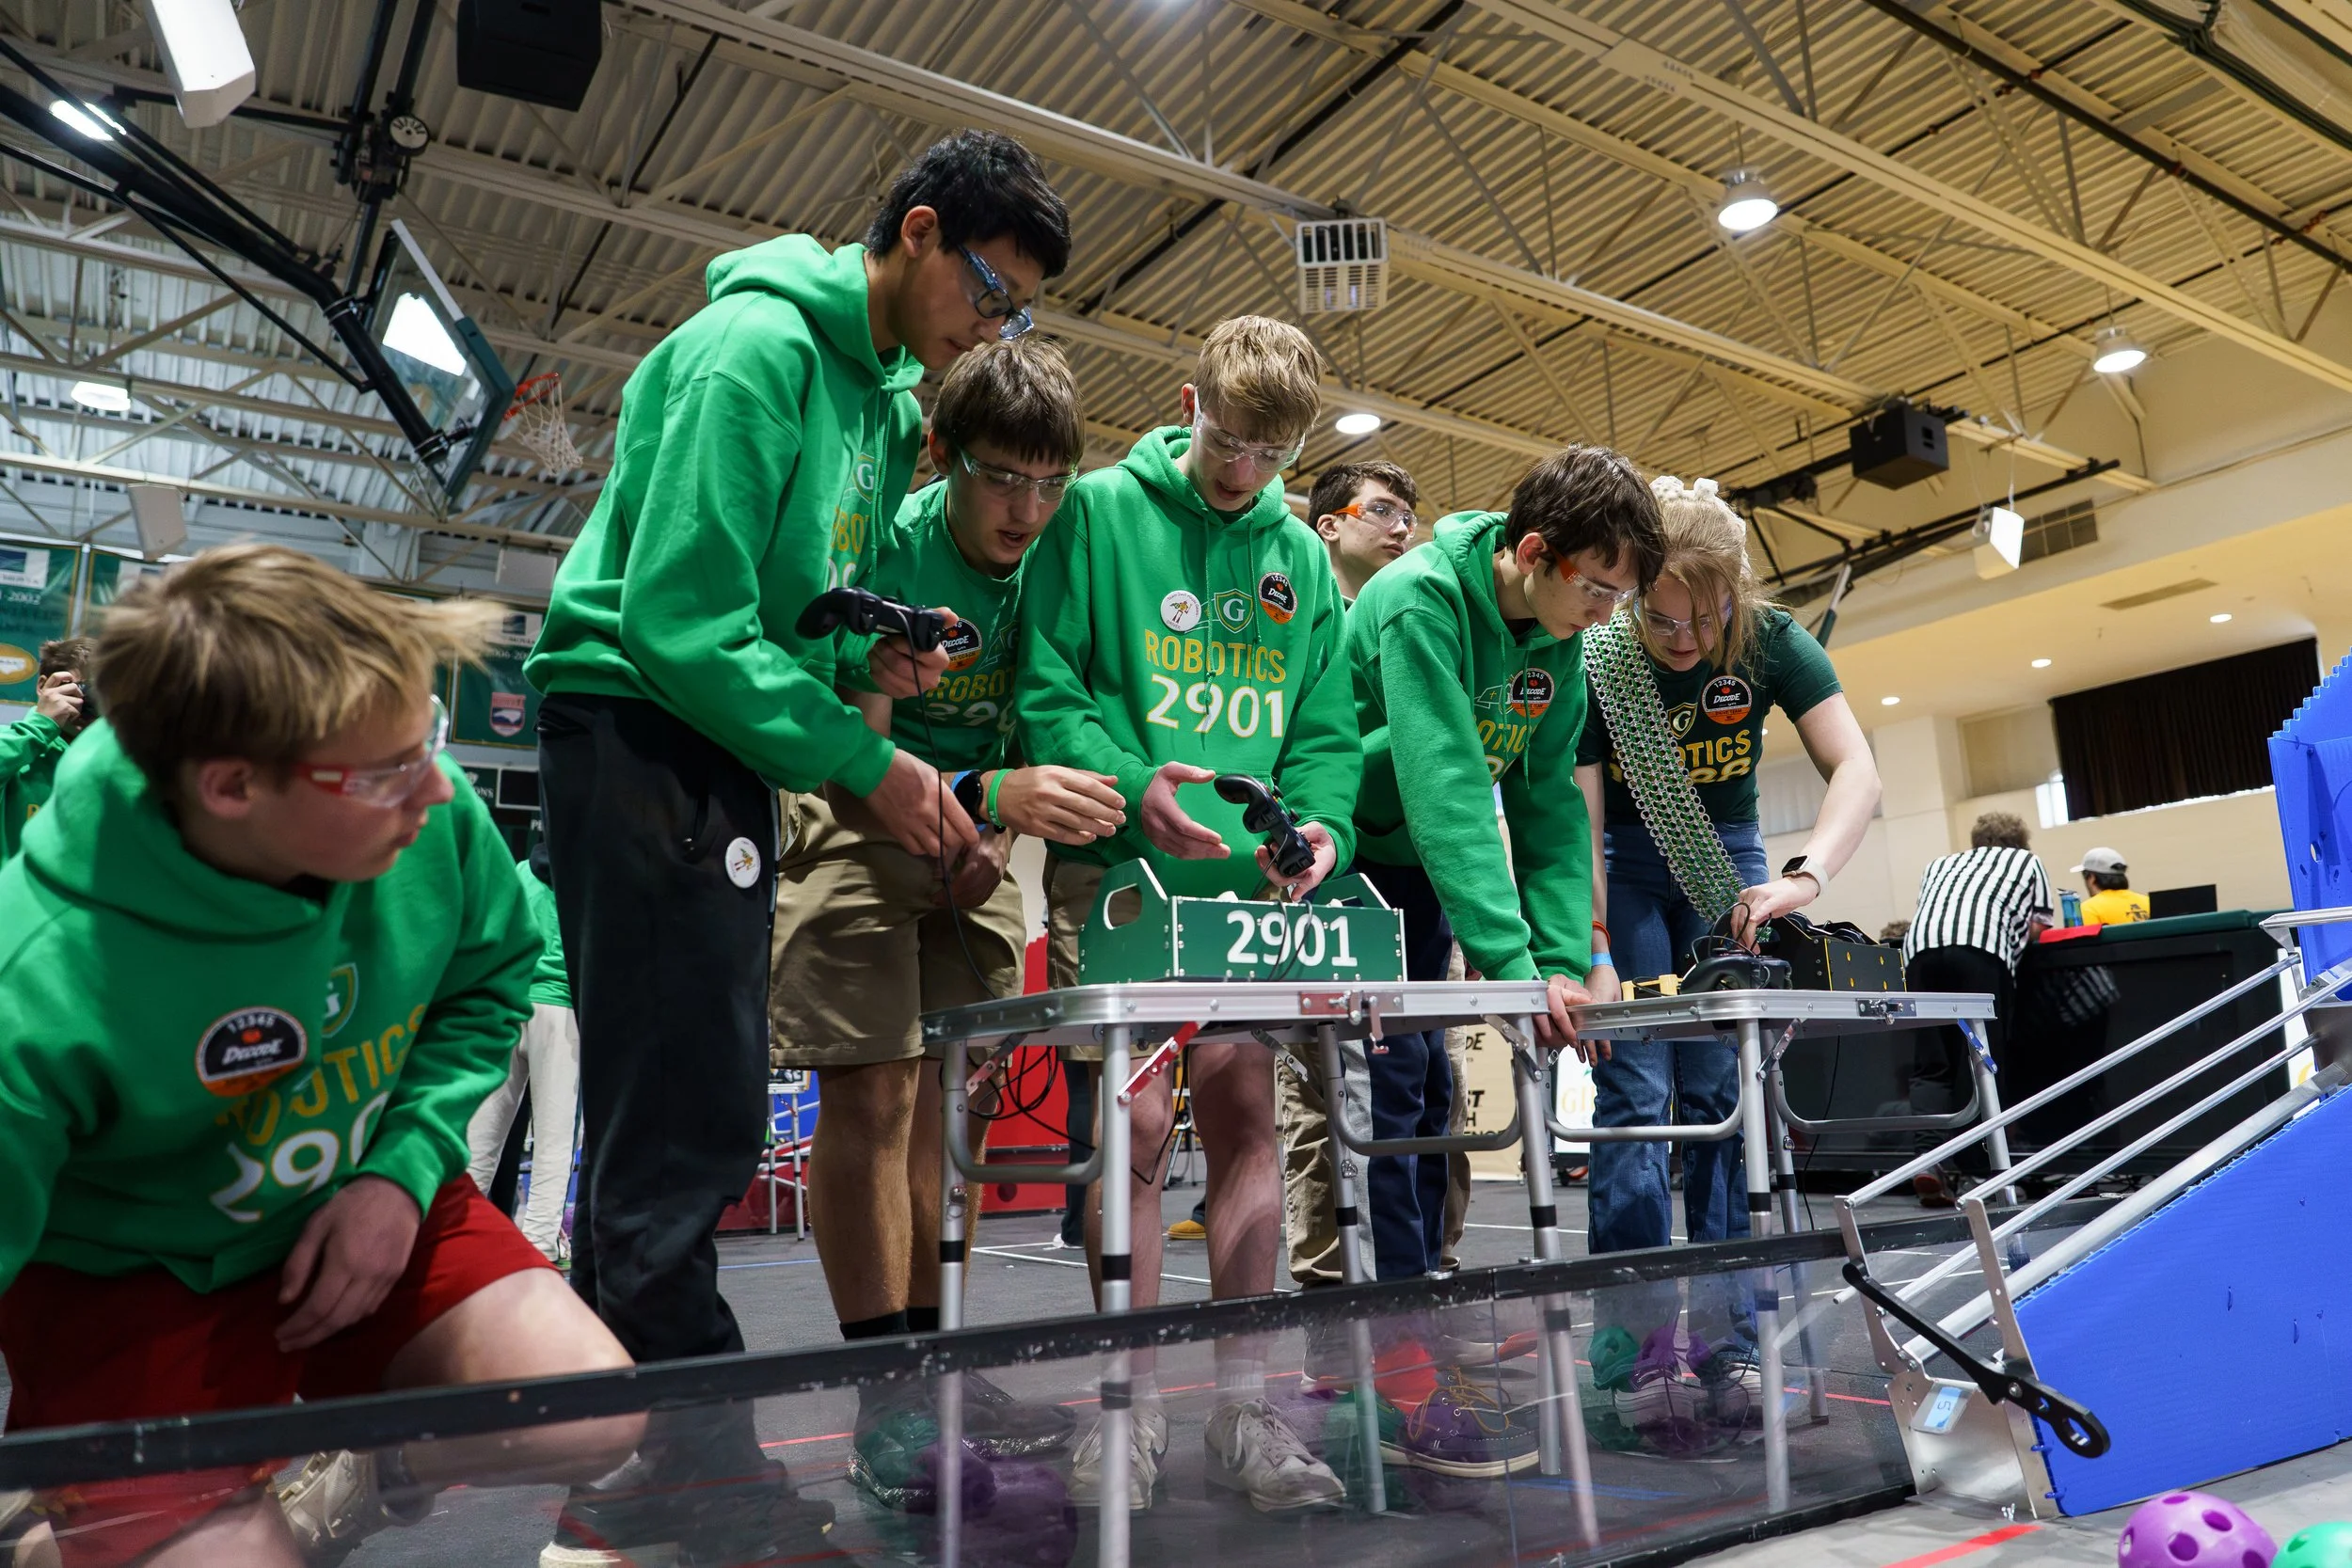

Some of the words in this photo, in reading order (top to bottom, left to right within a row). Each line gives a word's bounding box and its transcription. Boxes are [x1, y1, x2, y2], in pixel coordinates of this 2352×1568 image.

[857, 463, 875, 490] G
[1223, 598, 1246, 622] G
[942, 635, 970, 649] DECODE
[1145, 629, 1287, 684] ROBOTICS
[1527, 671, 1545, 680] 2345
[1714, 679, 1737, 688] 12345
[1146, 673, 1285, 738] 2901
[1713, 692, 1741, 705] DECODE
[1673, 711, 1692, 732] G
[1227, 910, 1359, 967] 2901
